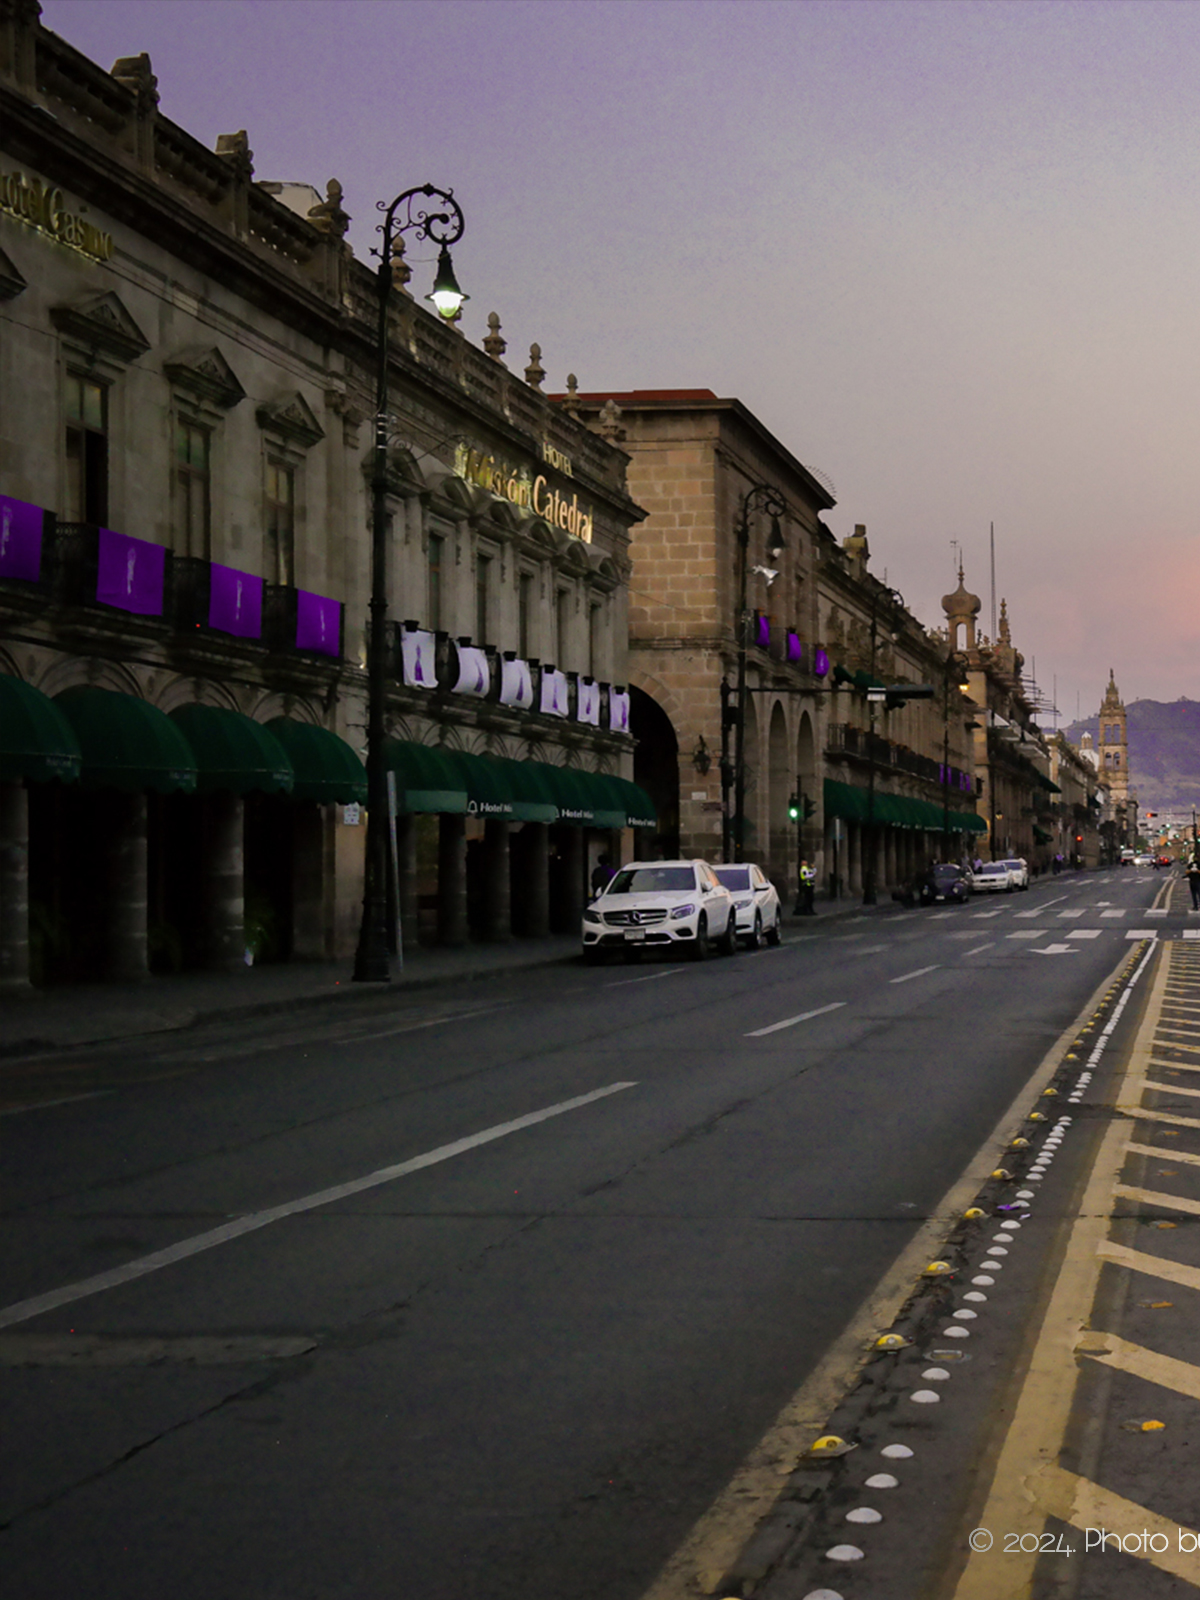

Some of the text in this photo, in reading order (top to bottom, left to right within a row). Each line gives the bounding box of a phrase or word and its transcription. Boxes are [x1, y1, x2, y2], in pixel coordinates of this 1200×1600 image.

[0, 170, 43, 222] otel
[542, 443, 574, 476] HOTEL
[464, 448, 593, 544] Misión Catedral
[480, 802, 503, 813] Hotel
[561, 808, 583, 819] Hotel
